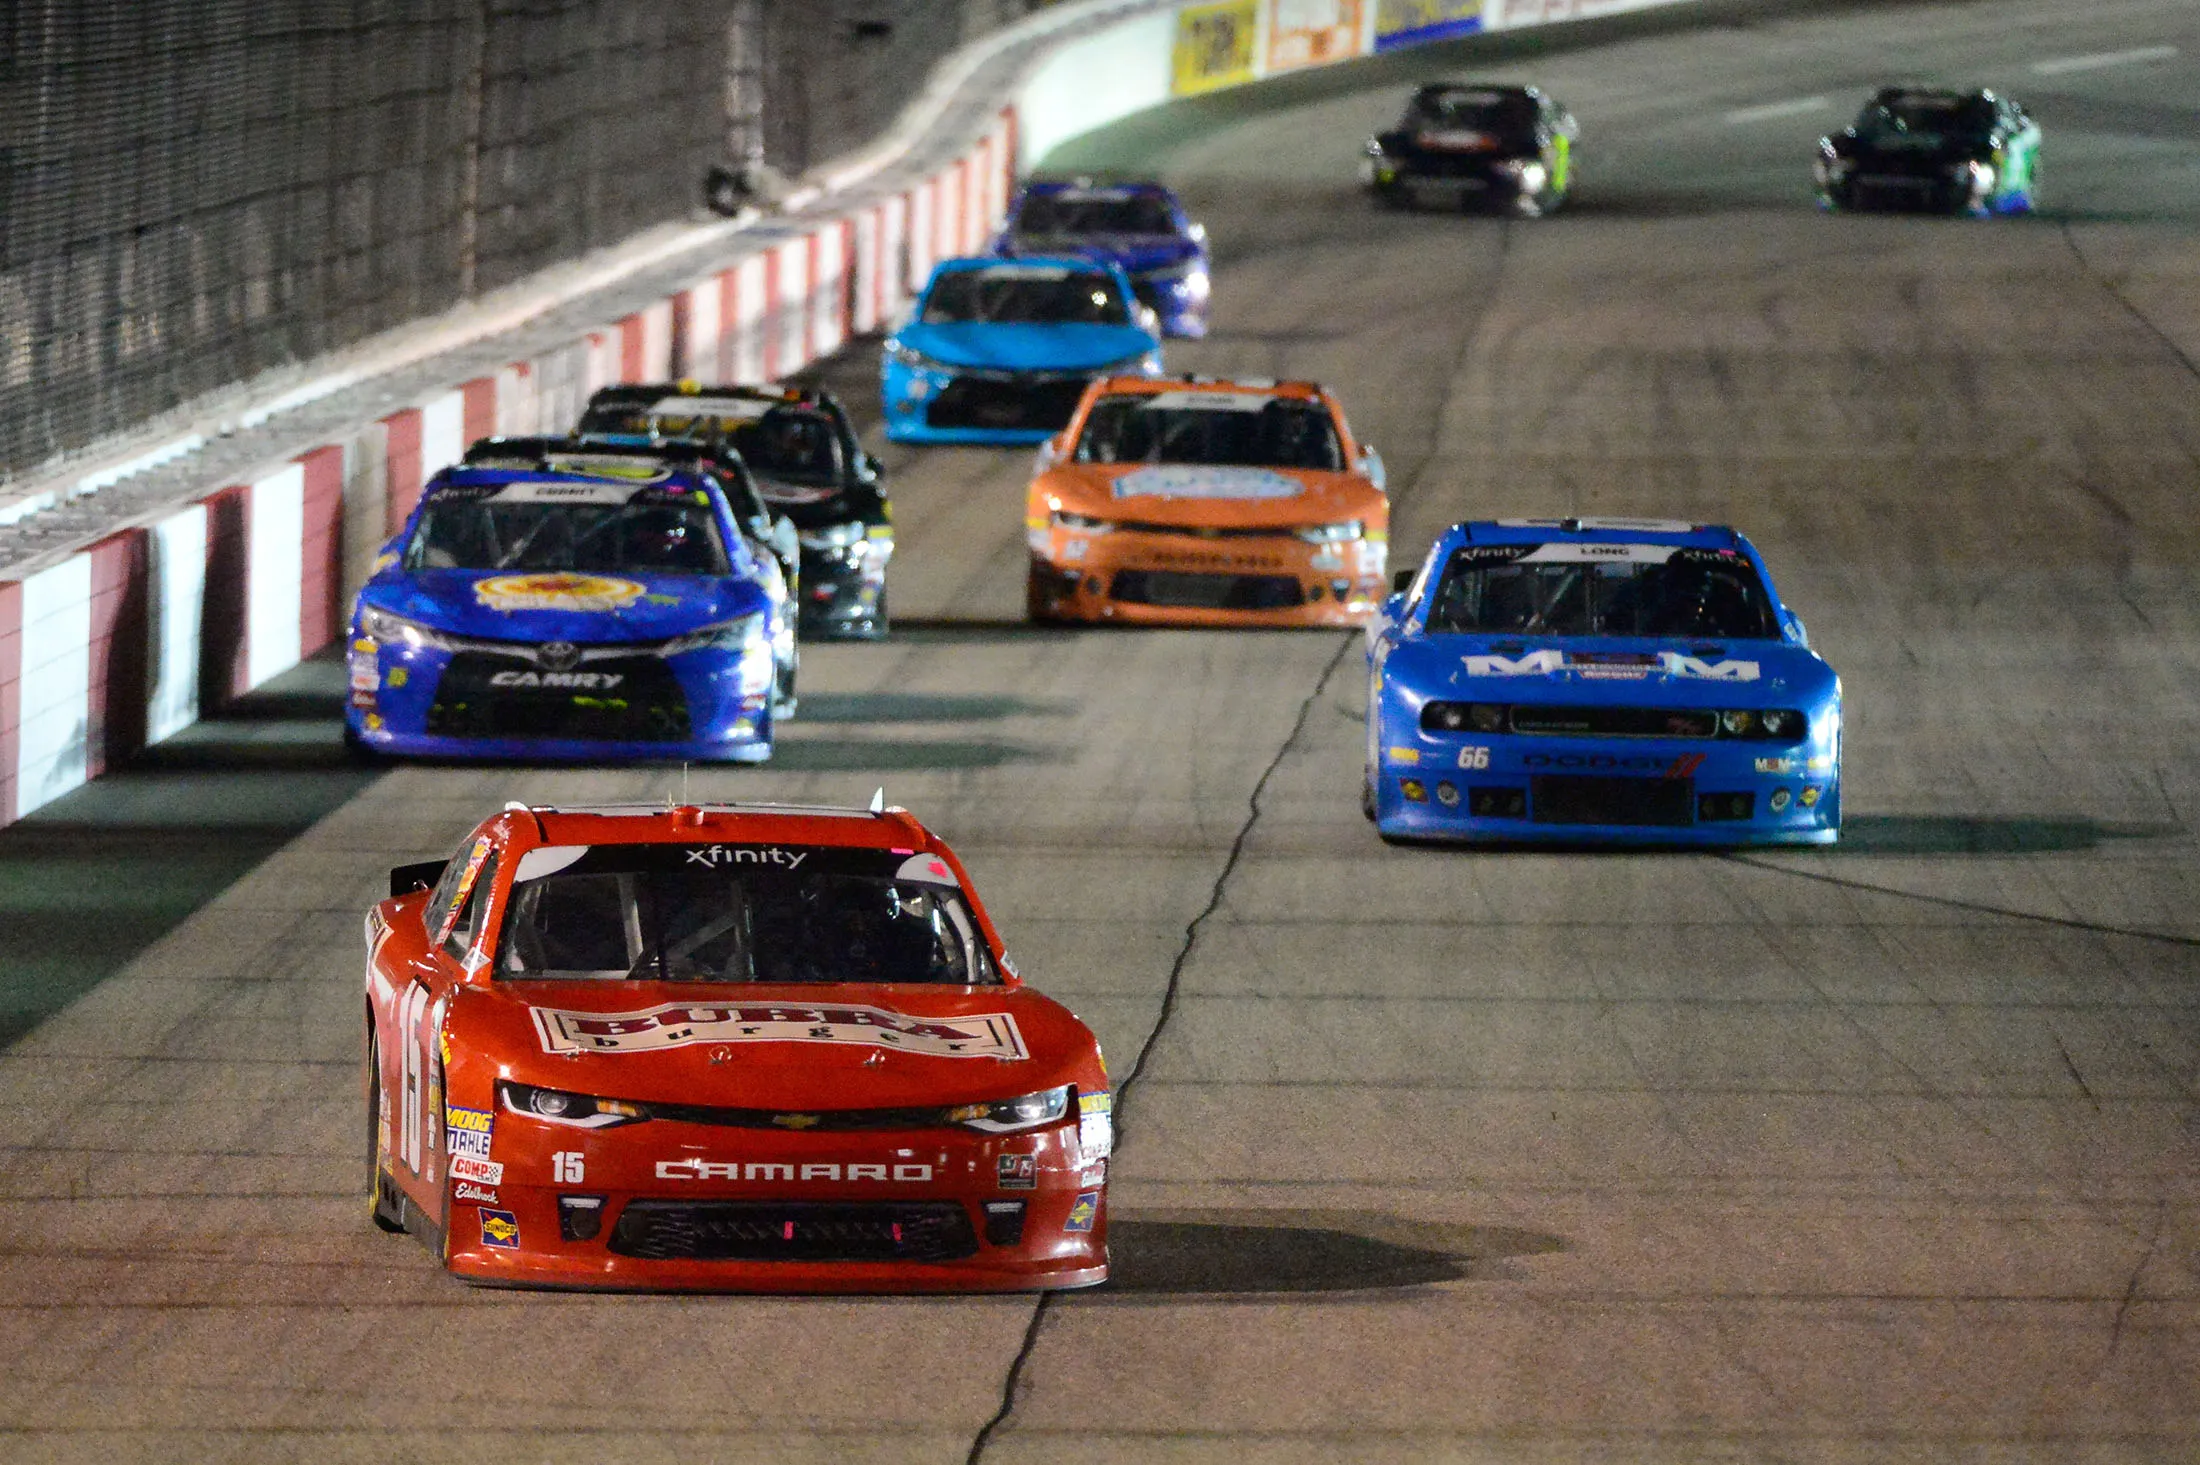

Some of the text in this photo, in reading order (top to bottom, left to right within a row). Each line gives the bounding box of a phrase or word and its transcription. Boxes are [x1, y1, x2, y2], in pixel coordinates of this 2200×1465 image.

[489, 670, 624, 688] CAMRY
[1458, 746, 1490, 770] 66
[686, 845, 808, 869] xfinity
[569, 1008, 982, 1040] BUBBA
[447, 1108, 493, 1132] MOOG
[448, 1130, 490, 1155] MAHLE
[455, 1158, 488, 1176] COMP
[552, 1151, 585, 1183] 15
[655, 1161, 933, 1181] CAMARO
[486, 1222, 515, 1235] SUNOCO
